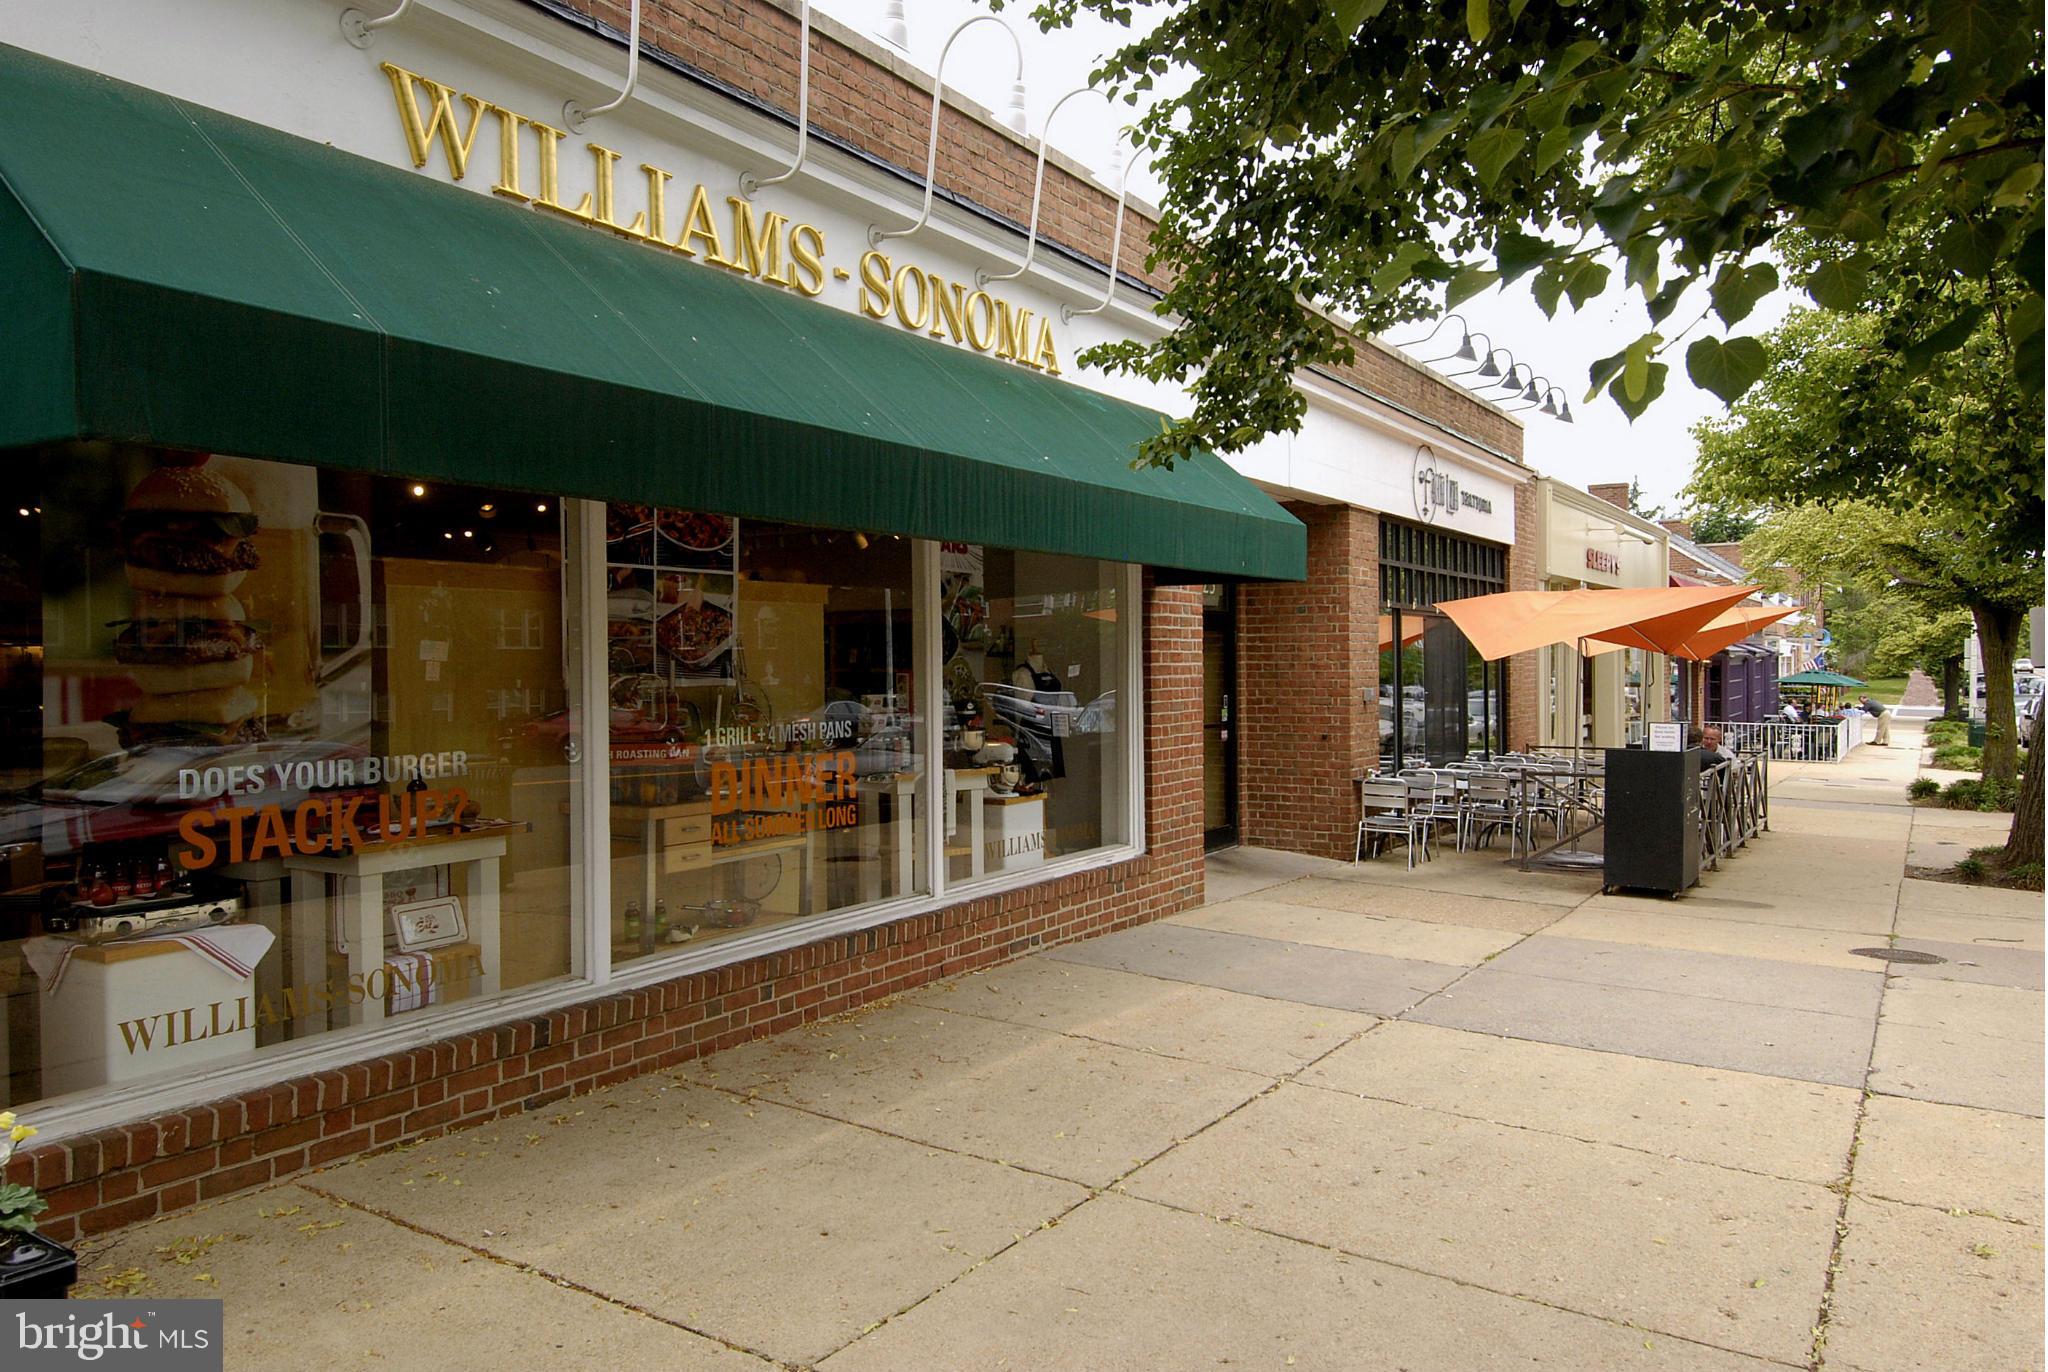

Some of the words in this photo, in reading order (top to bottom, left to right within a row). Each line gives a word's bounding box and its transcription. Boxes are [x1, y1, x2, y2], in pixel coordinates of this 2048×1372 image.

[616, 749, 667, 759] ROASTING
[704, 729, 711, 746] 1
[716, 726, 755, 747] GRILL
[768, 729, 776, 744] 4
[779, 722, 816, 743] MESH
[820, 720, 852, 740] PANS
[179, 765, 265, 800] DOES
[274, 759, 355, 792] YOUR
[363, 750, 469, 785] BURGER
[711, 751, 857, 816] DINNER
[178, 796, 366, 870] STACK
[379, 787, 470, 843] UP?
[712, 820, 740, 846] ALL
[744, 810, 815, 841] SUMMER
[818, 804, 857, 829] LONG
